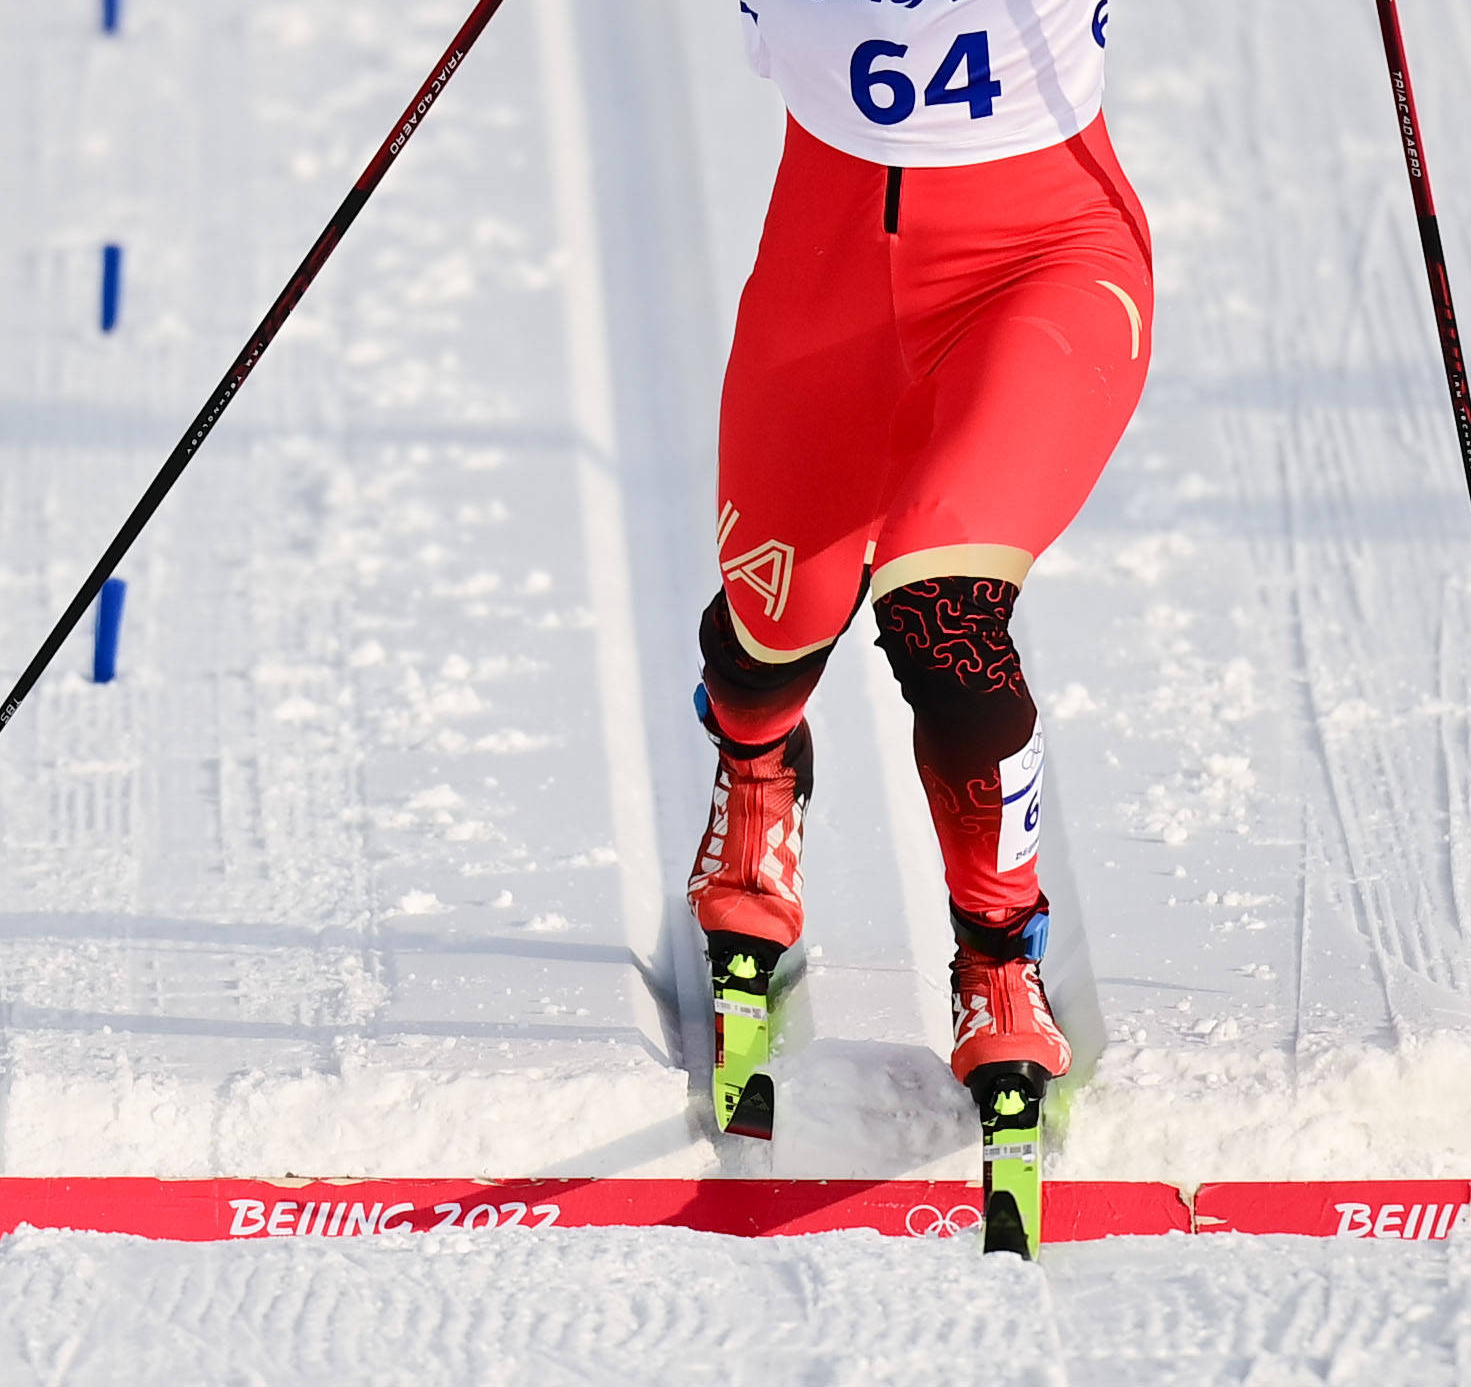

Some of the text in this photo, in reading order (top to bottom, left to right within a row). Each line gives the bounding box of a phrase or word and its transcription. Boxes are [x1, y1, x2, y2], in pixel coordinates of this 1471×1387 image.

[431, 50, 463, 95] TRIAC
[850, 31, 1002, 125] 64
[390, 113, 418, 155] AERO
[1393, 71, 1408, 113] TRIAC
[1406, 137, 1421, 178] AERO
[186, 375, 242, 454] TECHNOLOGY
[0, 698, 22, 724] TBS
[229, 1199, 562, 1237] BEIJING 2022
